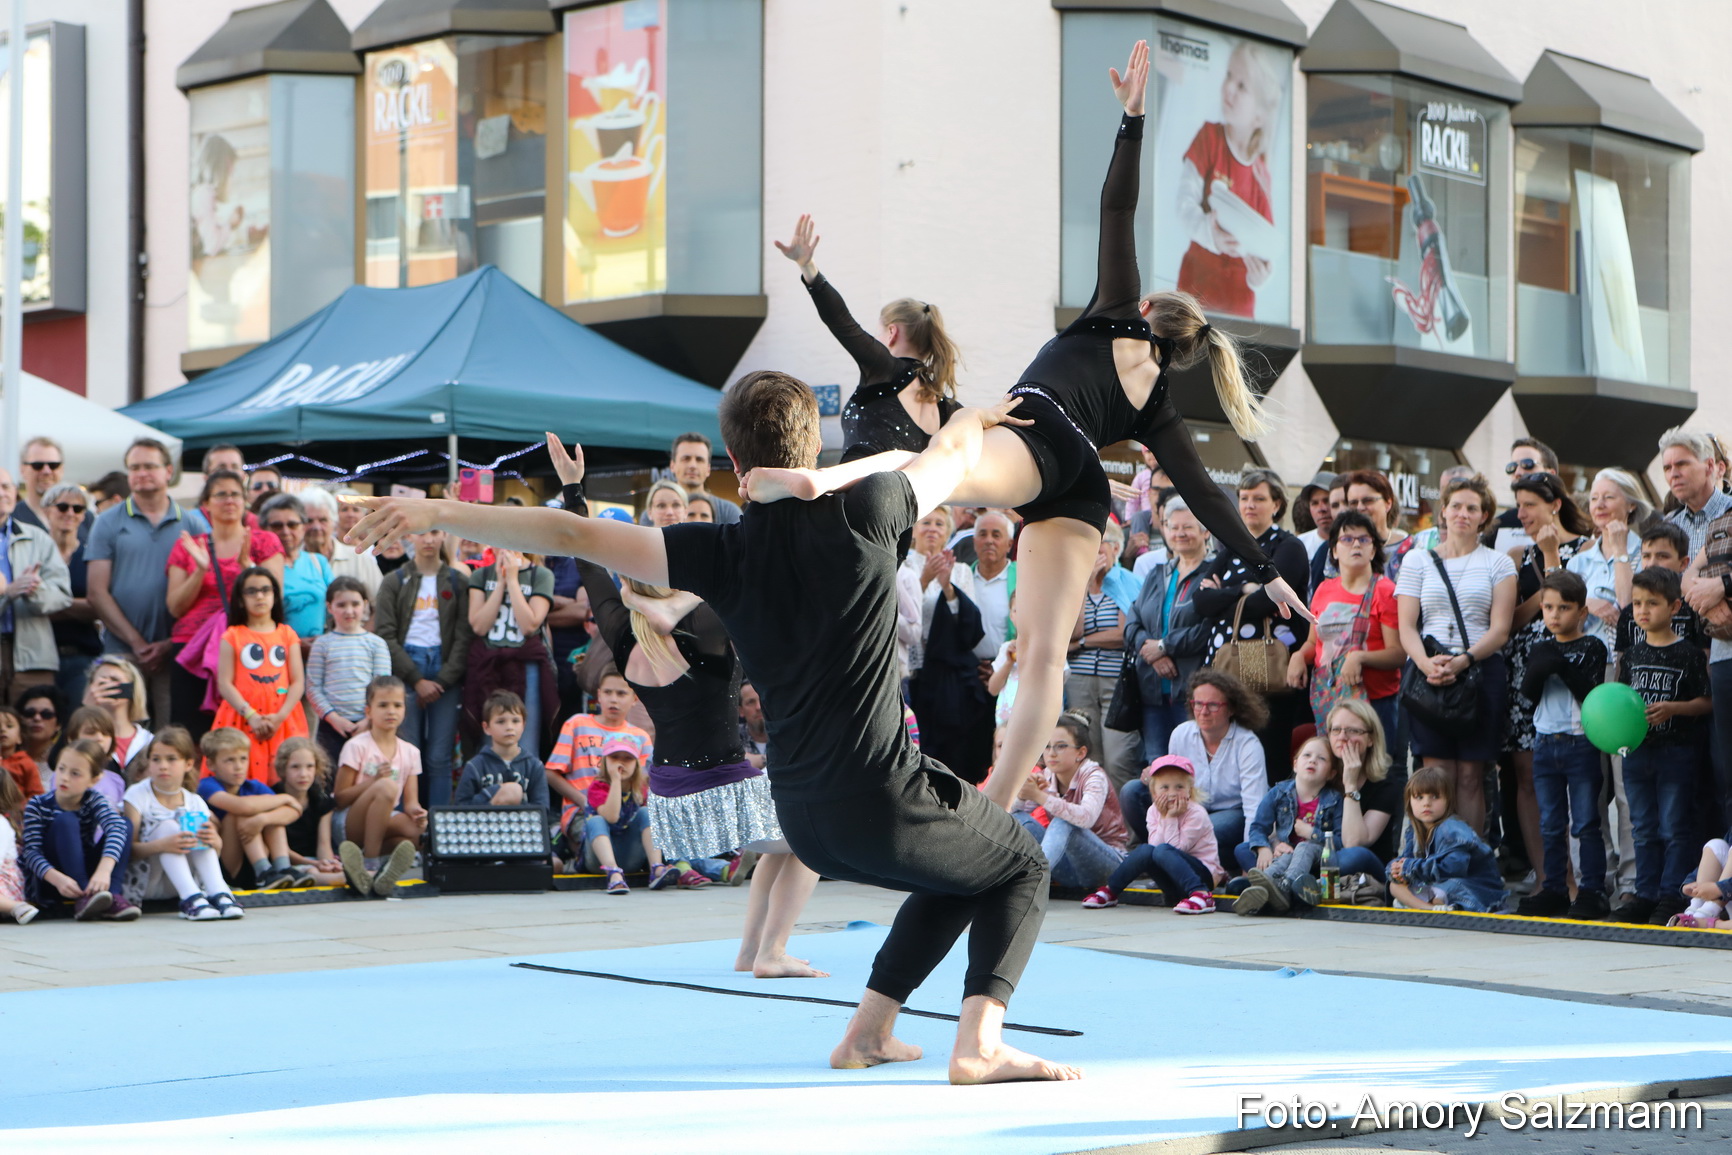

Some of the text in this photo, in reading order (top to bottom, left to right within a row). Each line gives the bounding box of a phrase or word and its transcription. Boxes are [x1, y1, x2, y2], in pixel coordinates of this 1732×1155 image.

[1158, 31, 1210, 61] Thomas
[374, 83, 432, 132] RACKL
[1426, 102, 1478, 124] 100 Jahre
[1421, 121, 1470, 171] RACKL
[1380, 470, 1420, 508] ACKL
